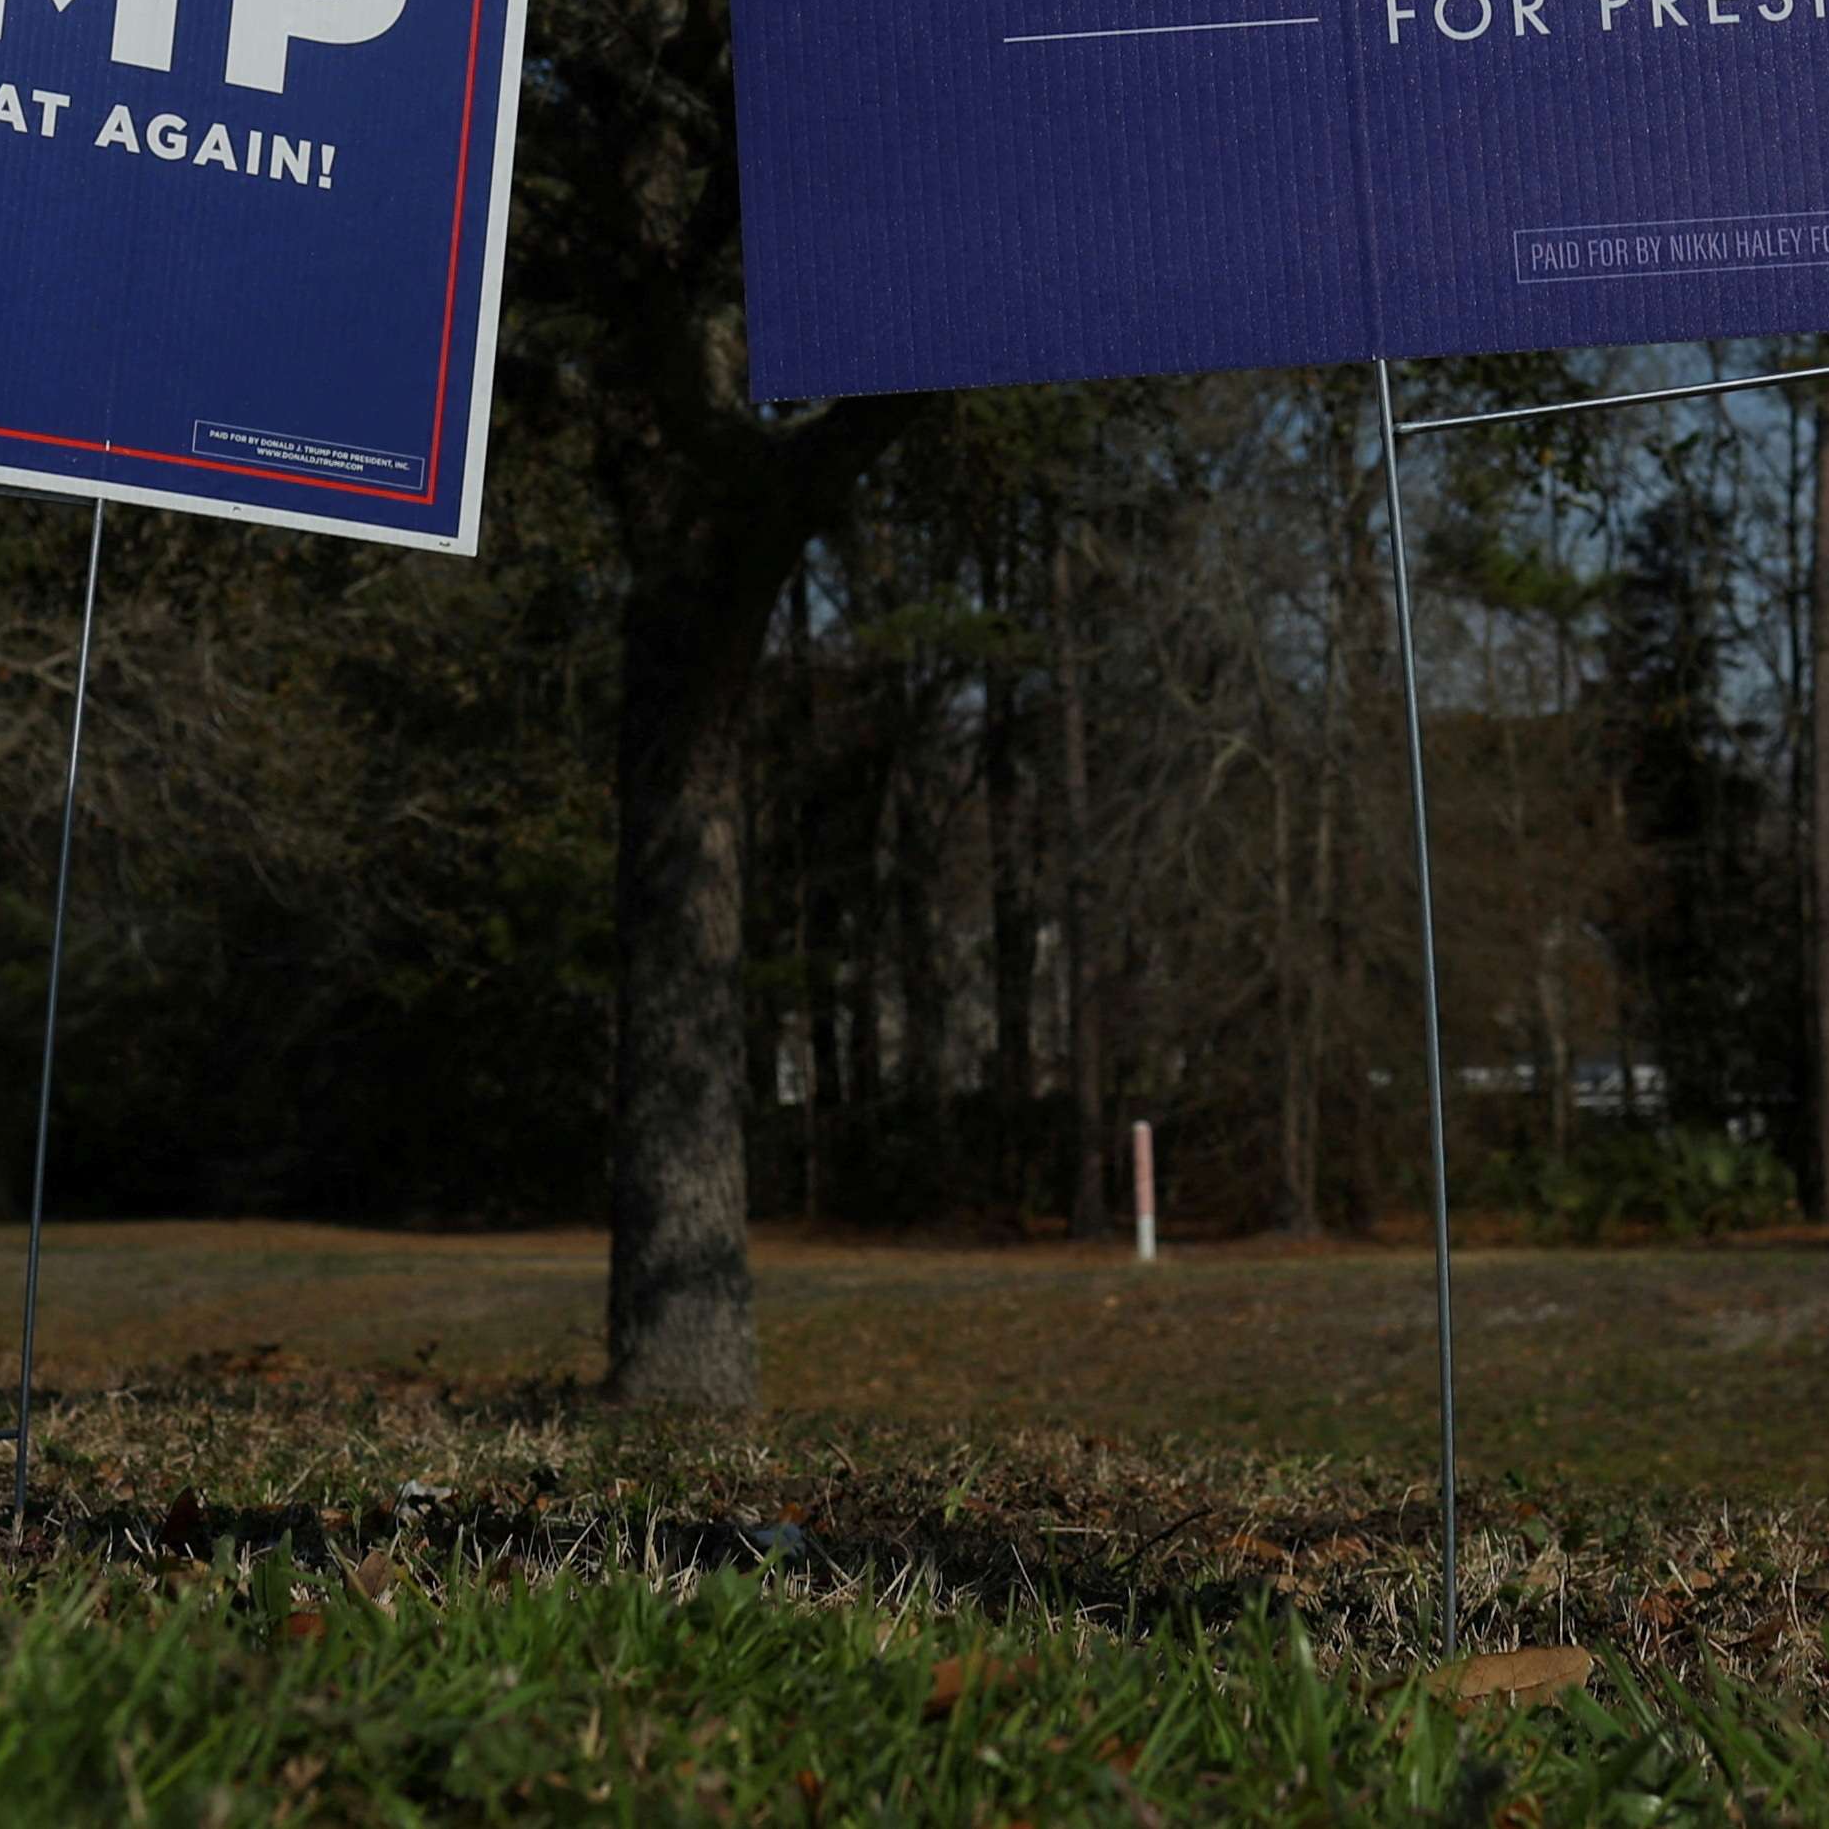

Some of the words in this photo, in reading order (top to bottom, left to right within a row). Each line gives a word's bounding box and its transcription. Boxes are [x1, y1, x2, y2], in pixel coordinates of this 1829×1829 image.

[94, 104, 338, 191] AGAIN!
[1531, 241, 1580, 271] PAID
[1588, 238, 1629, 267] FOR
[1636, 235, 1661, 264] BY
[1670, 231, 1727, 262] NIKKI
[1735, 228, 1802, 258] HALEY
[209, 430, 228, 440] PAID
[230, 433, 247, 443] FOR
[248, 437, 259, 446] BY
[261, 438, 294, 451] DONALD
[304, 445, 331, 456] TRUMP
[332, 450, 348, 460] FOR
